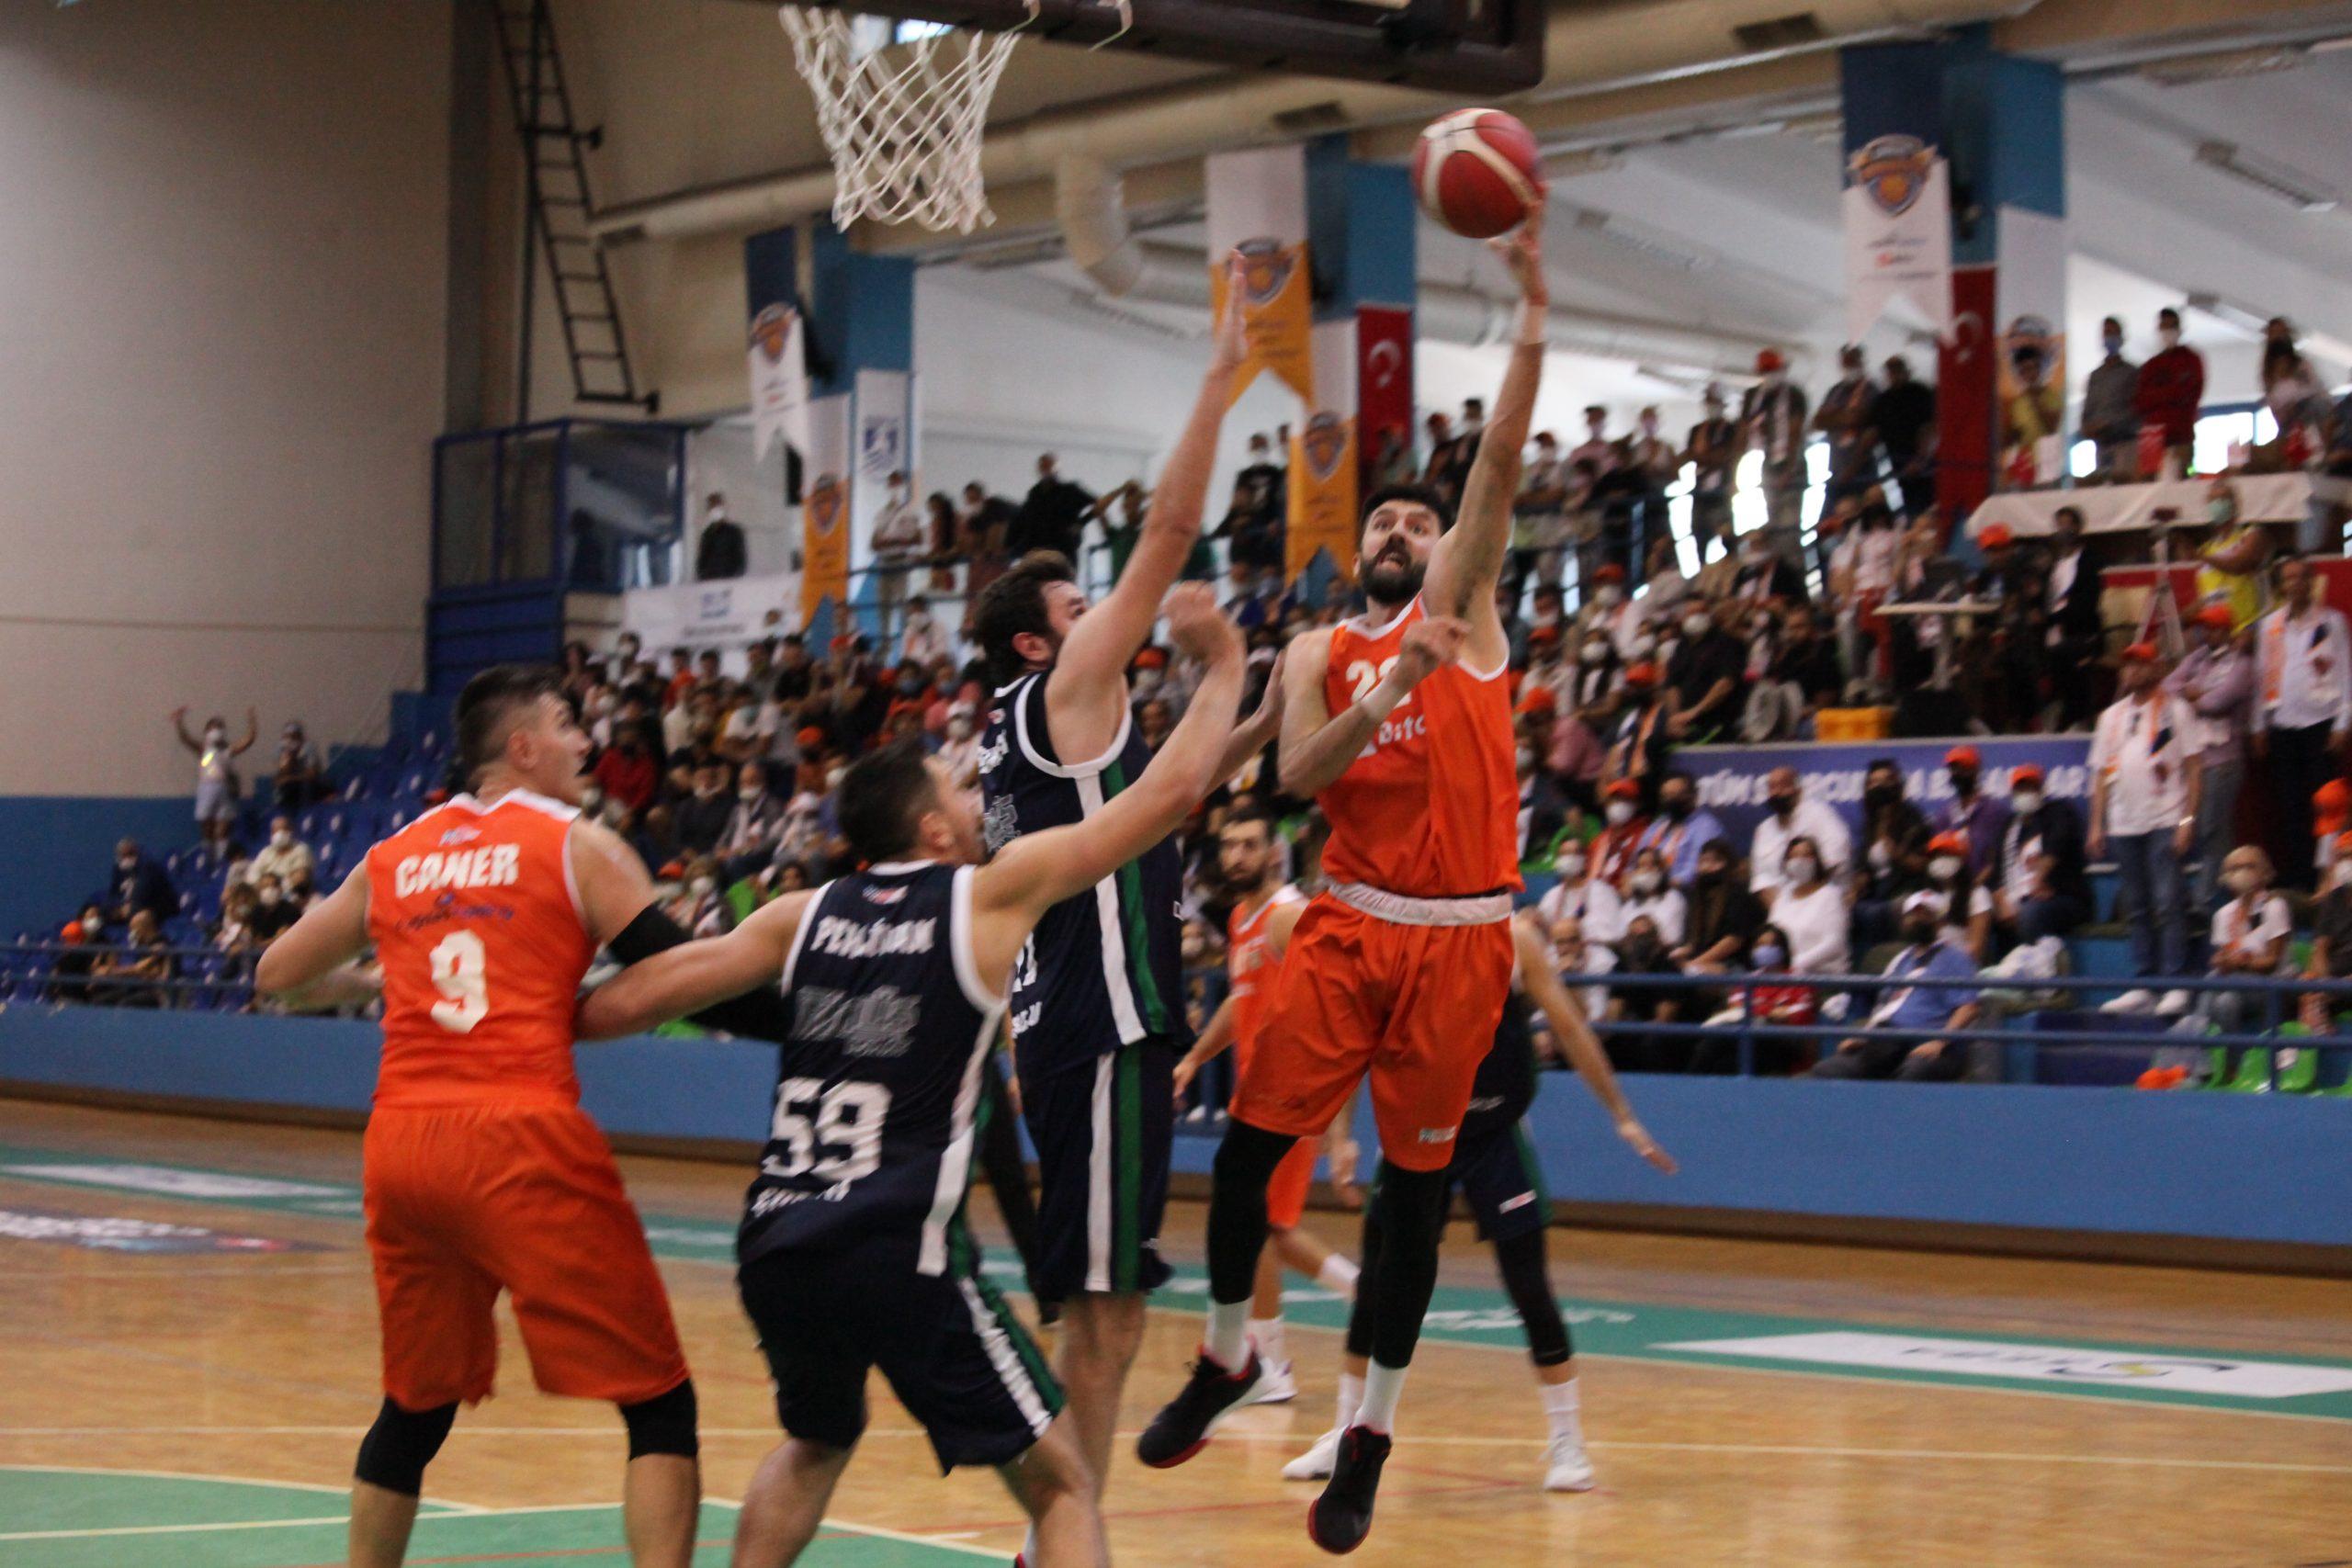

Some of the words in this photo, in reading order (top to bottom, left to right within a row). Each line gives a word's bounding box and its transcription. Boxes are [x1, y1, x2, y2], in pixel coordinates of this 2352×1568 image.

[395, 842, 521, 899] CANER
[428, 928, 490, 1034] 9
[761, 1076, 894, 1182] 59
